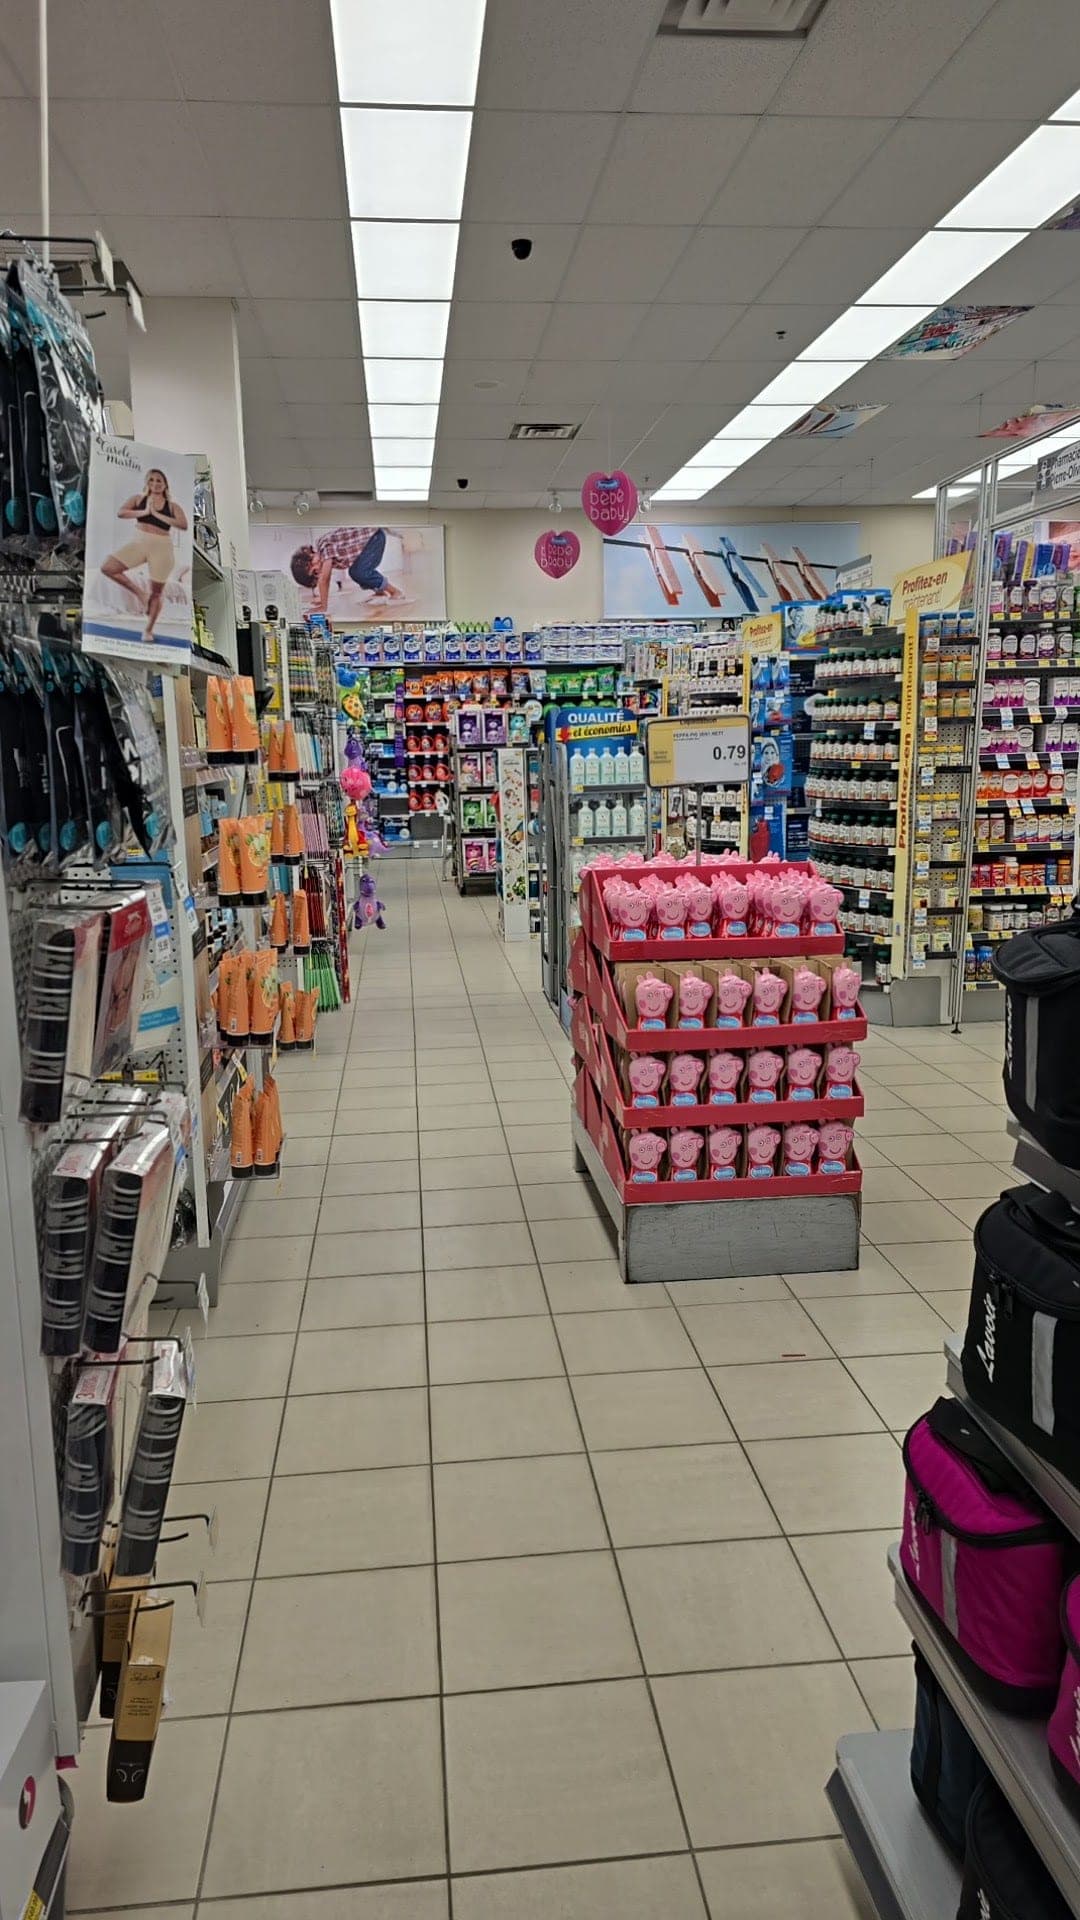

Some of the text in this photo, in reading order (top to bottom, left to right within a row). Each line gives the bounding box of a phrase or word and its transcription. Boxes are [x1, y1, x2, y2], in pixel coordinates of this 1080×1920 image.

[902, 571, 948, 596] Profitez-en
[567, 711, 624, 724] QUALITÉ
[573, 723, 631, 737] et économies
[712, 744, 746, 760] 0.79
[899, 733, 911, 848] Profitez-en
